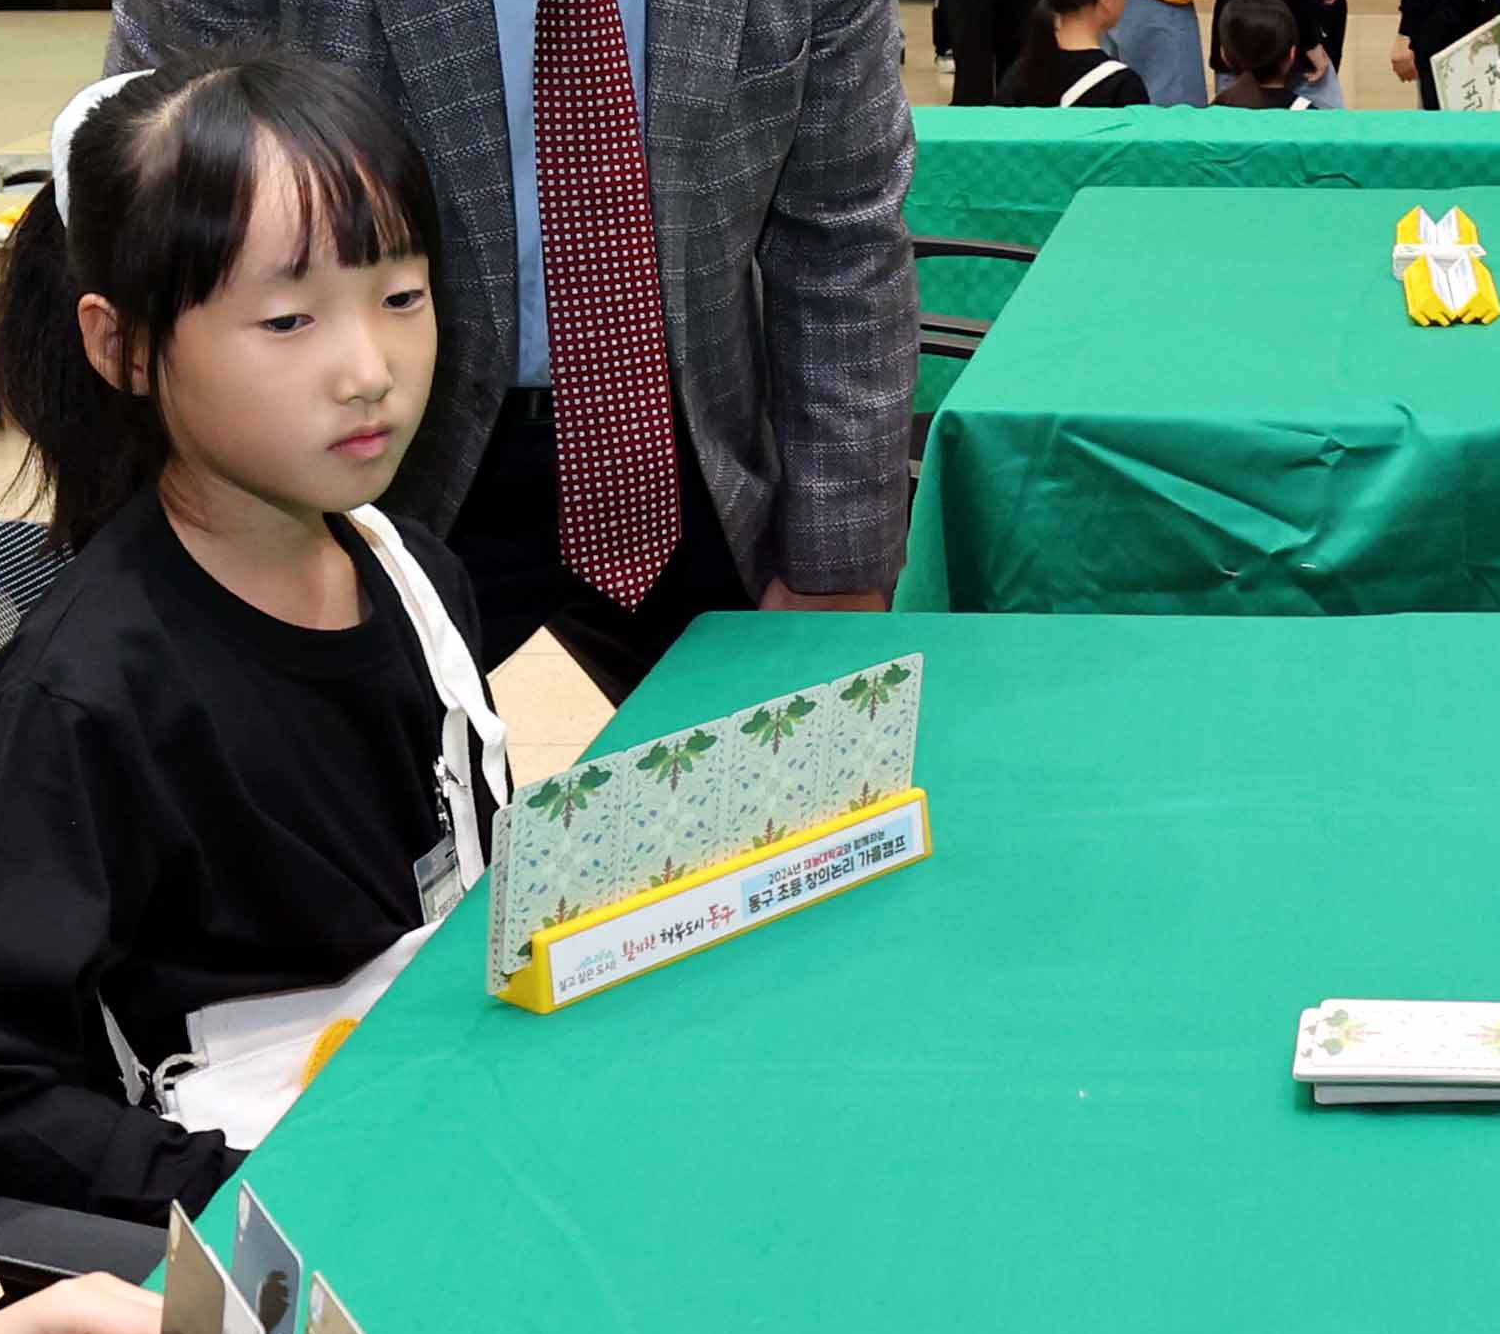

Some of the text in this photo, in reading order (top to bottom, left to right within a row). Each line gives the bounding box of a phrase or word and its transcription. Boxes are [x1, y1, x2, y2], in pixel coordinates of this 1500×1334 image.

[748, 835, 907, 914] 동구 초등 창의논리 가을캠프
[768, 858, 801, 885] 2024년
[706, 902, 737, 931] 동구
